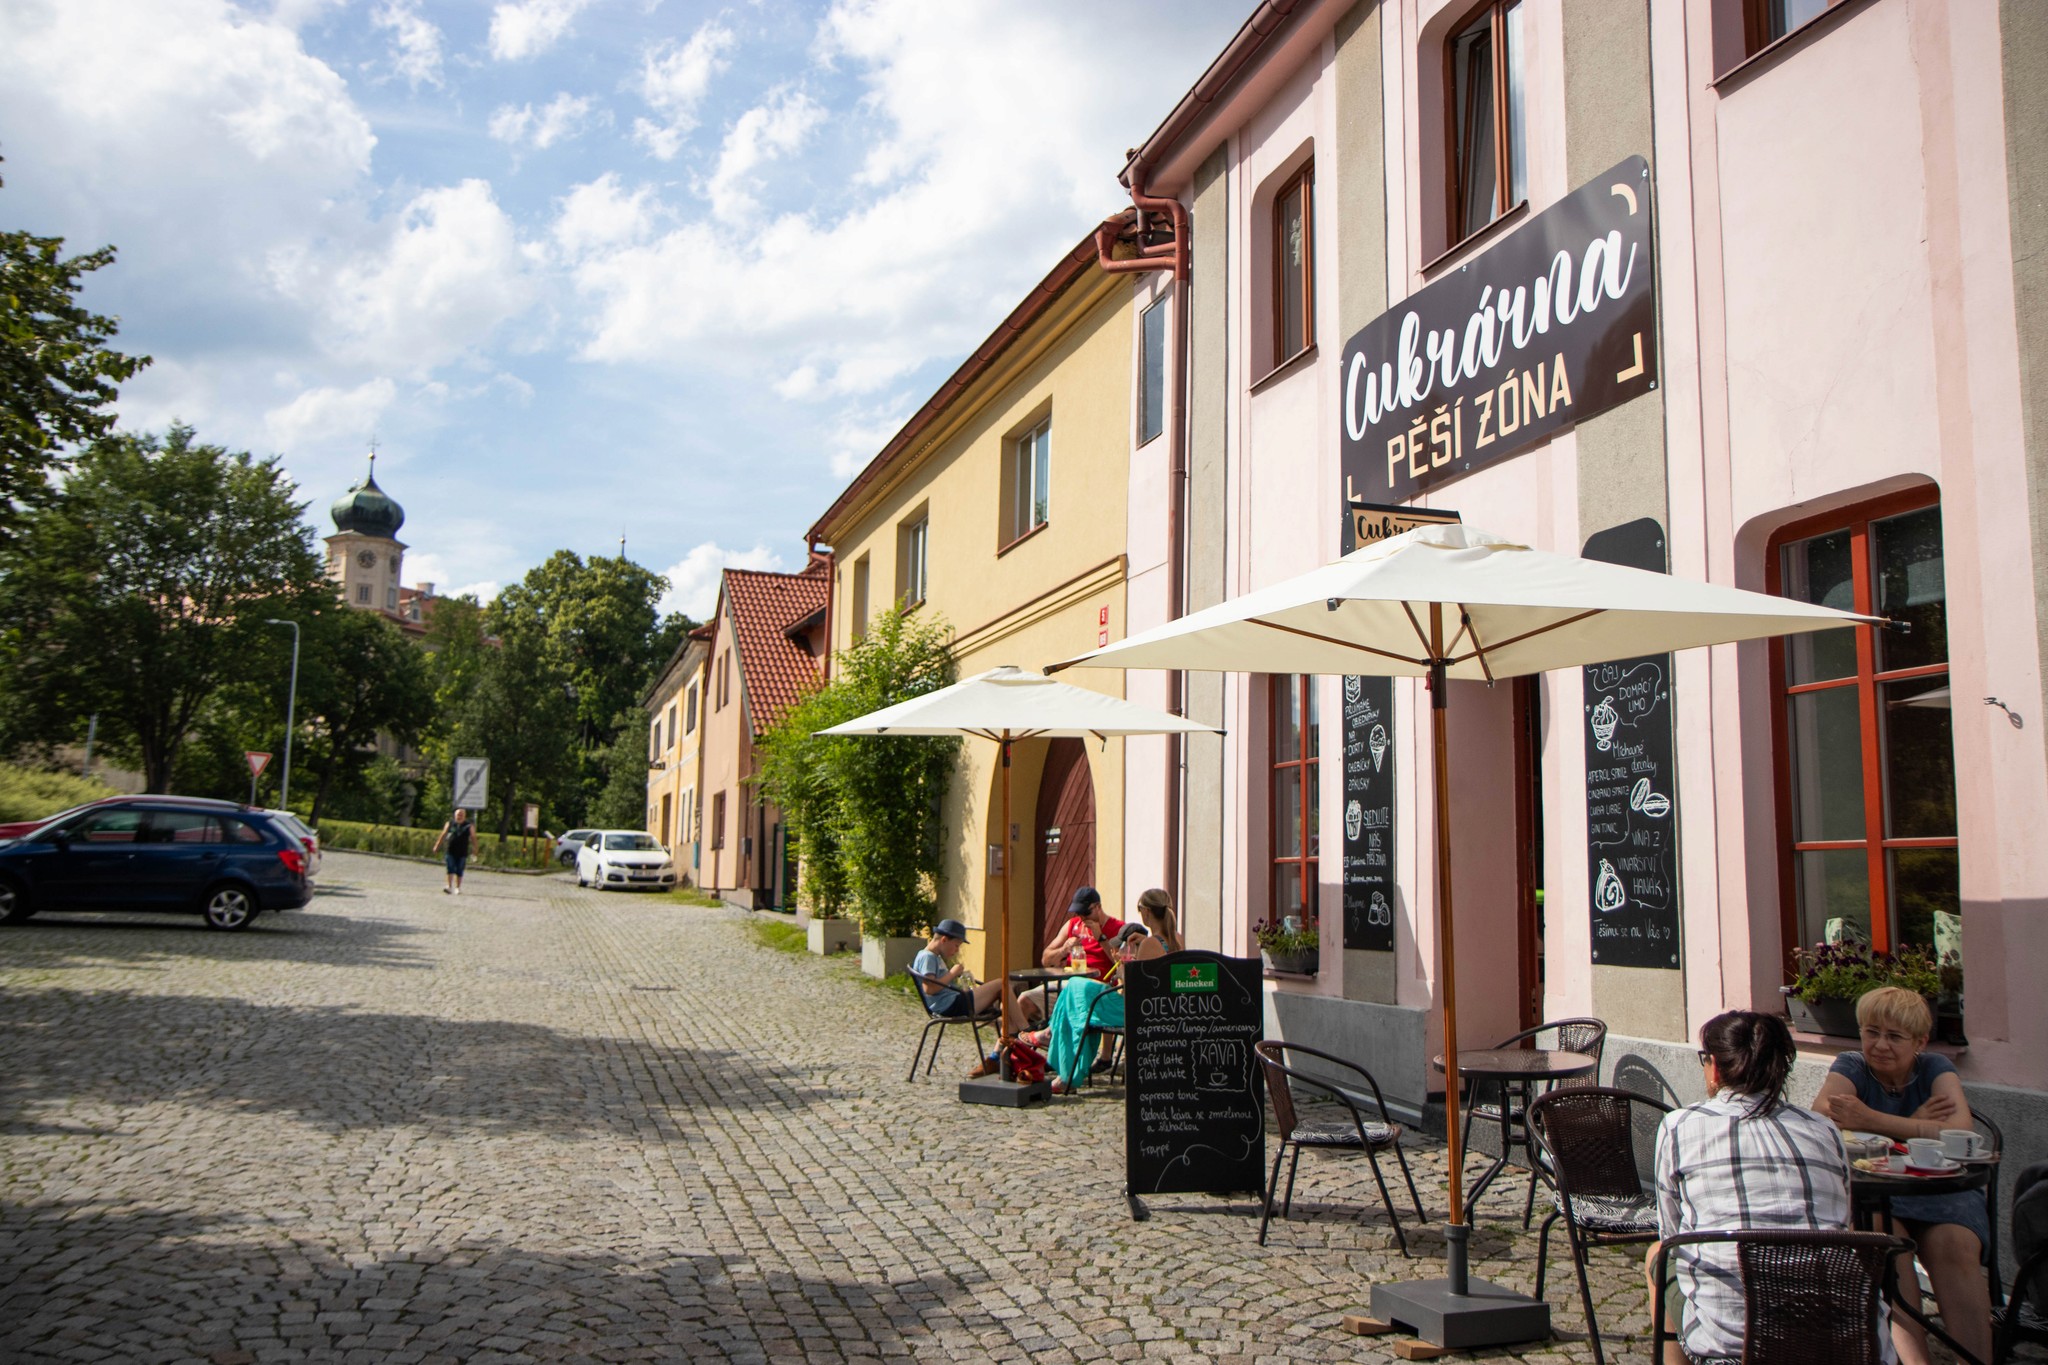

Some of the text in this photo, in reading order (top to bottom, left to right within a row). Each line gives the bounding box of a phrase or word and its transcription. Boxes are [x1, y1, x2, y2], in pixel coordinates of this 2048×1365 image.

[1345, 230, 1638, 442] Cukrárna
[1386, 352, 1572, 489] PĚŠÍ ZÓNA
[1602, 663, 1619, 684] ČAJ
[1619, 677, 1652, 700] DOMÁCÍ
[1628, 698, 1646, 713] LIMO
[1348, 741, 1364, 756] DORTY
[1587, 769, 1611, 784] APEROL
[1631, 758, 1657, 778] drinky
[1590, 804, 1605, 817] CUBA
[1368, 829, 1382, 847] NÁS
[1631, 828, 1651, 848] VÍNA
[1632, 873, 1663, 897] HANÁK
[1630, 927, 1642, 938] na
[1175, 979, 1215, 988] Heineken
[1140, 993, 1223, 1016] OTEVŘENO
[1137, 1038, 1188, 1052] cappuccino
[1199, 1038, 1237, 1067] KÁVA
[1163, 1052, 1184, 1066] latte
[1159, 1067, 1187, 1080] white
[1139, 1089, 1200, 1106] espresso tonic
[1140, 1106, 1169, 1122] ledová
[1170, 1105, 1193, 1120] káva
[1208, 1106, 1254, 1120] zmrzlinou
[1146, 1125, 1155, 1133] a
[1140, 1140, 1171, 1158] frappé
